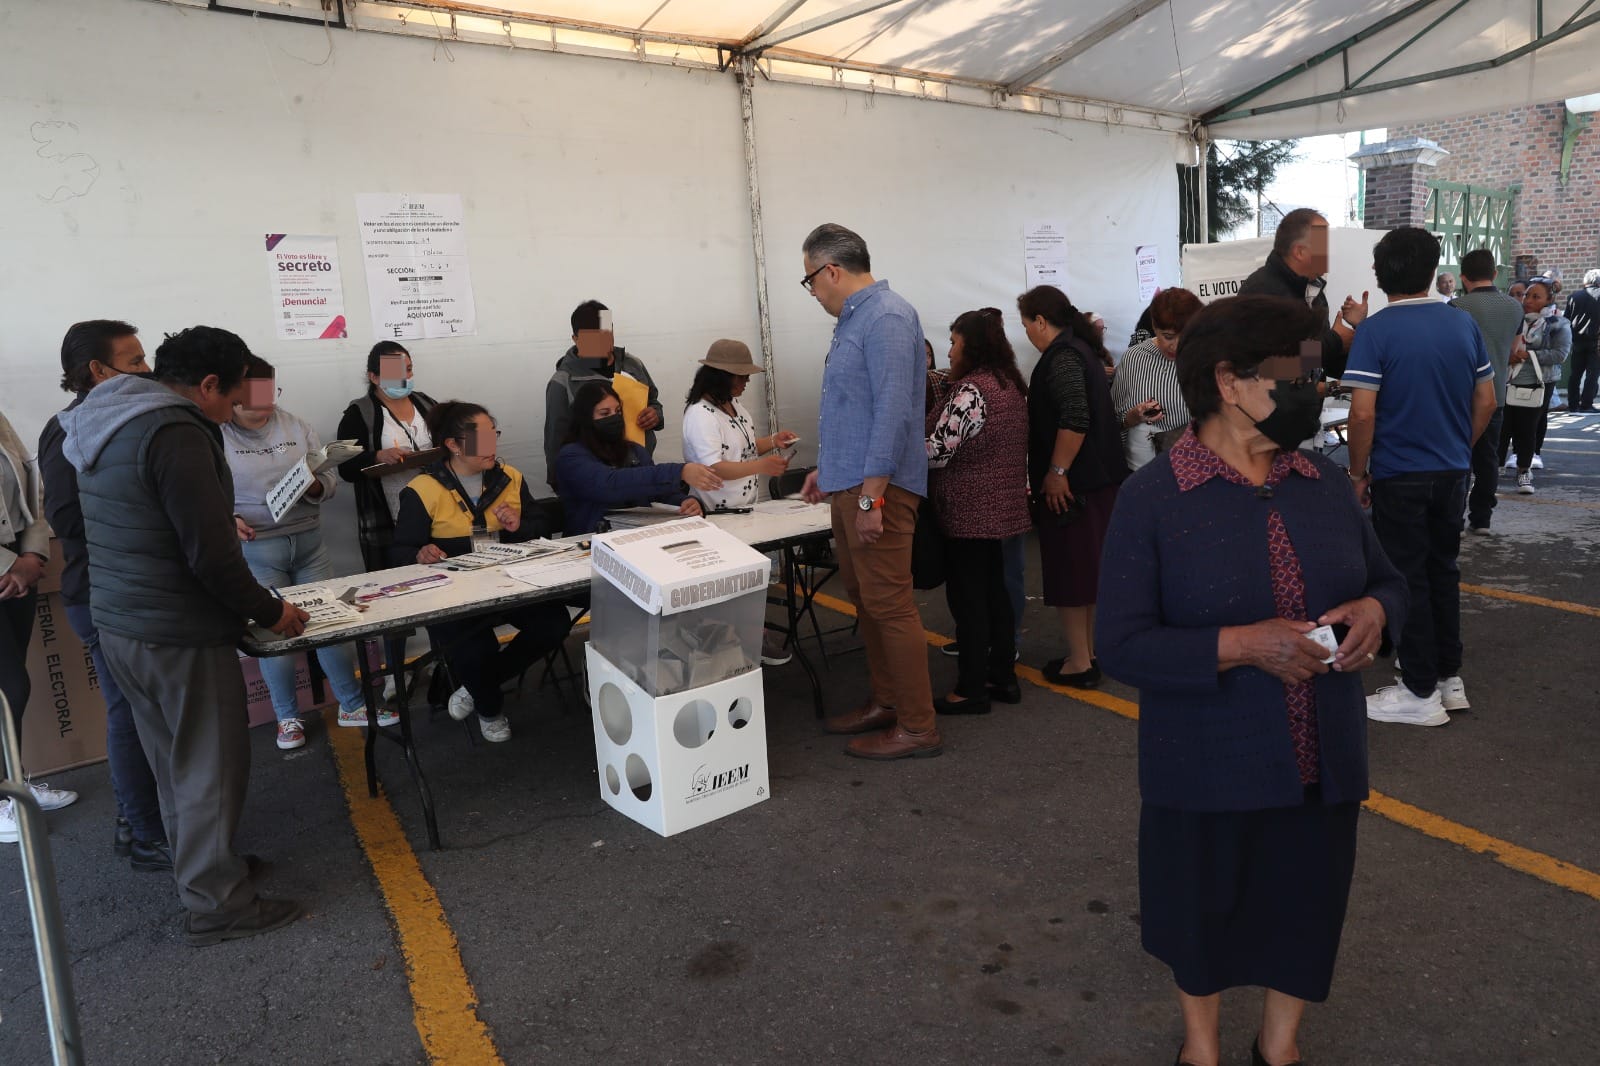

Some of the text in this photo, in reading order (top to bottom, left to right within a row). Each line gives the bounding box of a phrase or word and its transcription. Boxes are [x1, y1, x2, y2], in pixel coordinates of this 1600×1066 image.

[278, 260, 332, 272] secreto
[282, 296, 327, 308] ¡Denuncia!
[1199, 283, 1211, 297] EL
[1212, 280, 1238, 296] VOTO
[593, 545, 653, 606] GUBERNATURA
[670, 568, 764, 609] GUBERNATURA
[37, 594, 57, 648] TERIAL
[46, 653, 74, 738] ELECTORAL
[712, 763, 749, 790] IEEM
